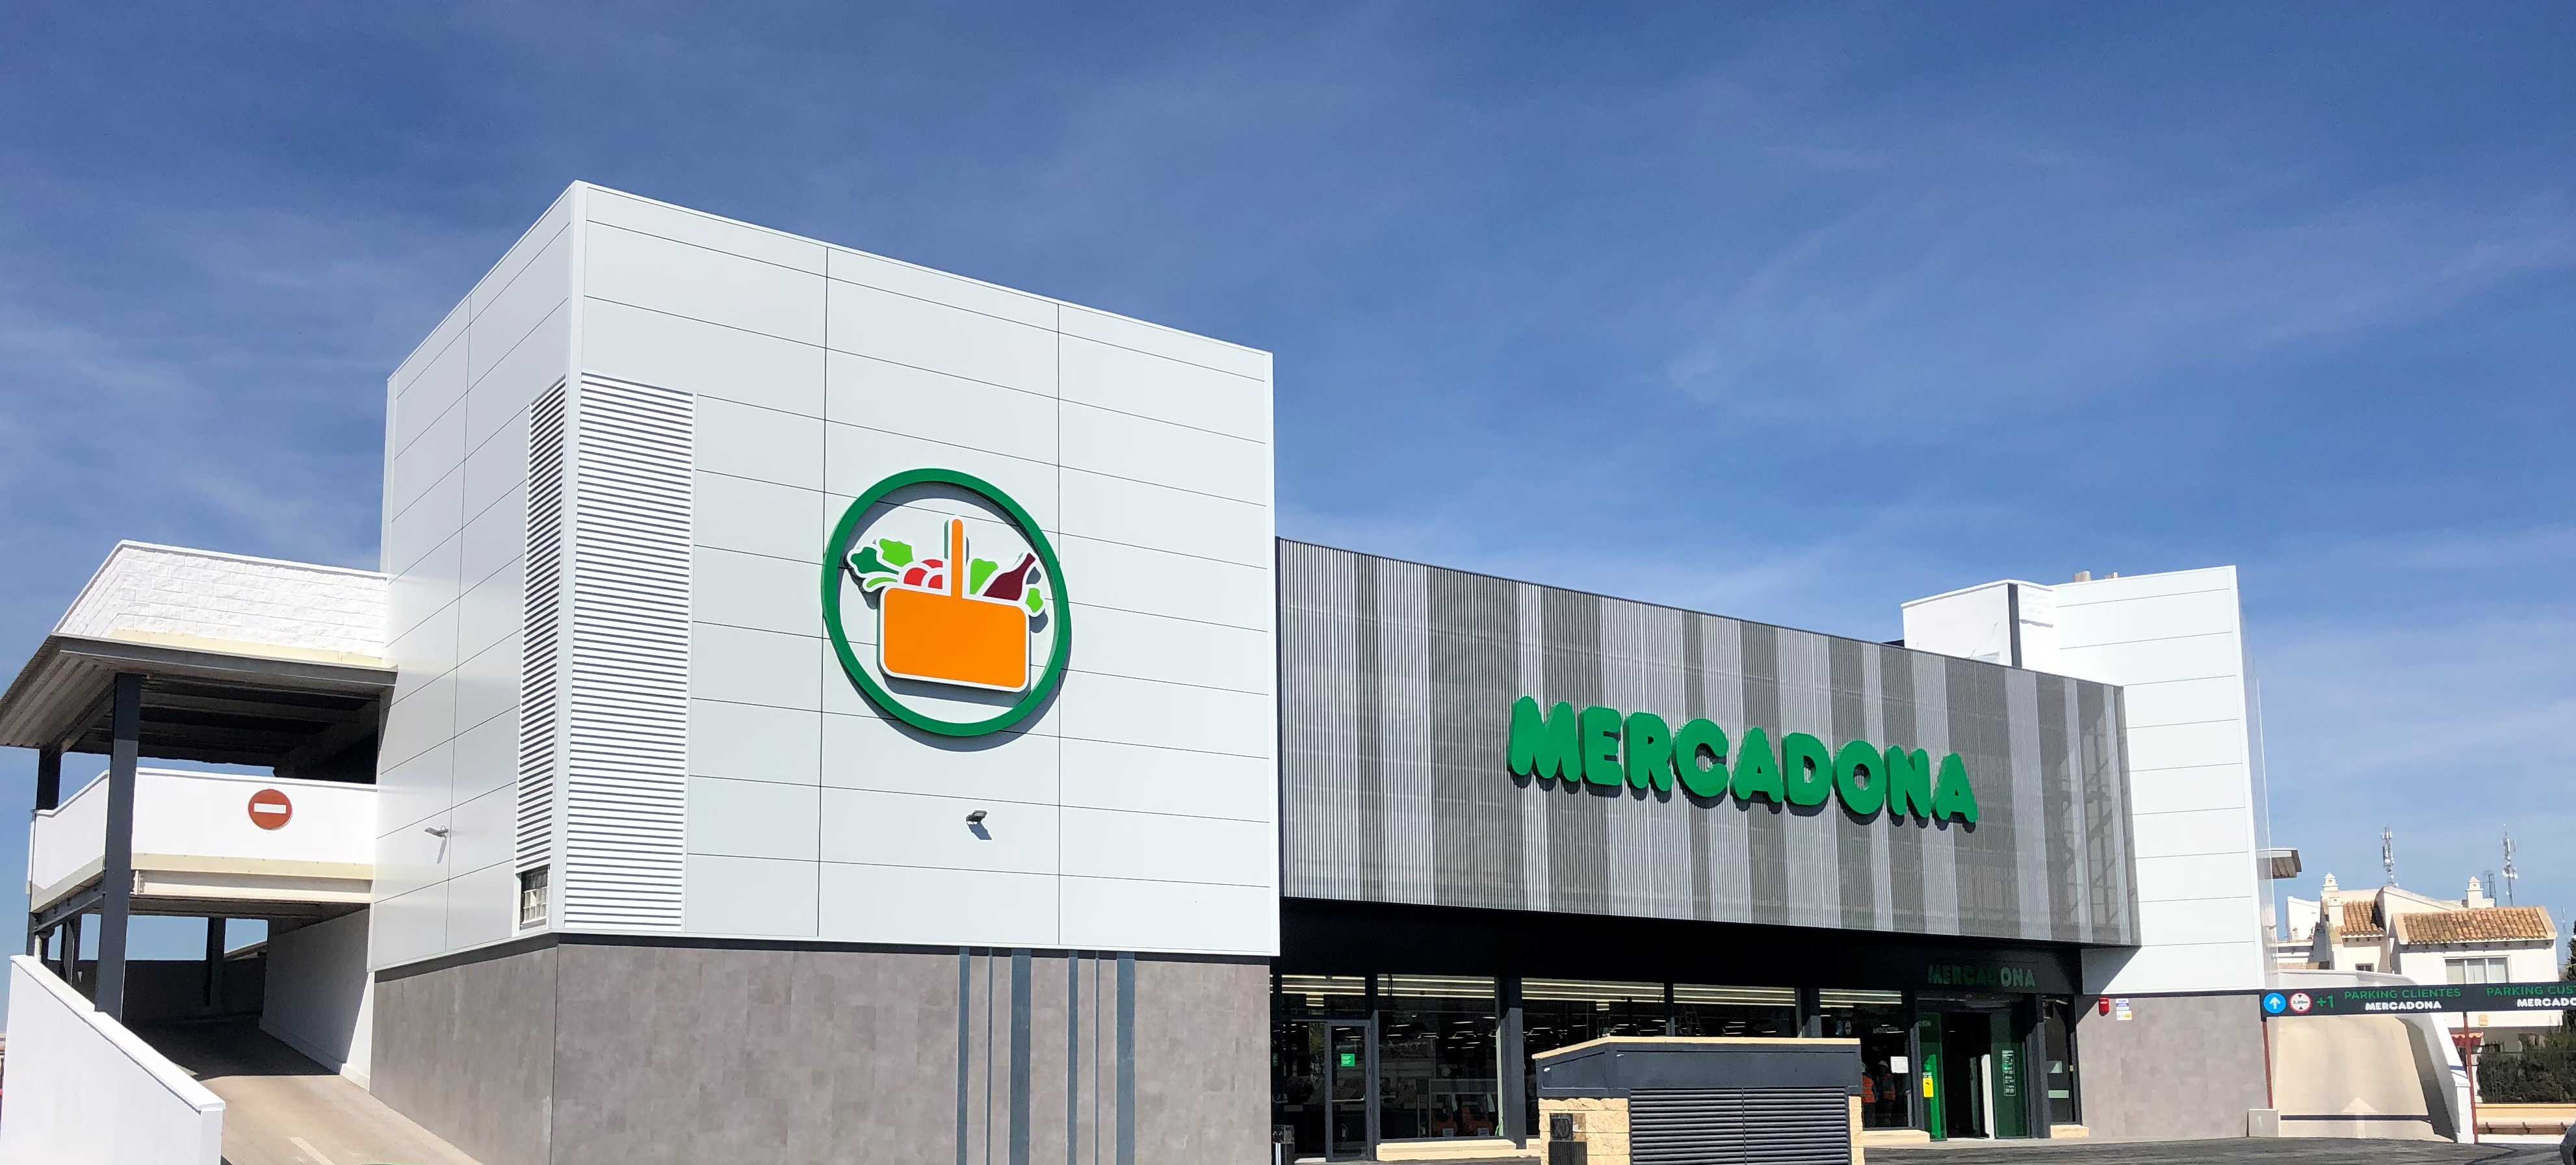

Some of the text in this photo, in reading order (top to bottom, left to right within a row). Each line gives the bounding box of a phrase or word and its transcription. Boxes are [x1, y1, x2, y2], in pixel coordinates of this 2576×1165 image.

[1507, 696, 1979, 824] MERCADONA
[2344, 988, 2461, 999] PARKING CLIENTES
[2486, 986, 2543, 997] PARKING
[2317, 994, 2335, 1008] +1
[2365, 1001, 2442, 1011] MERCADONA
